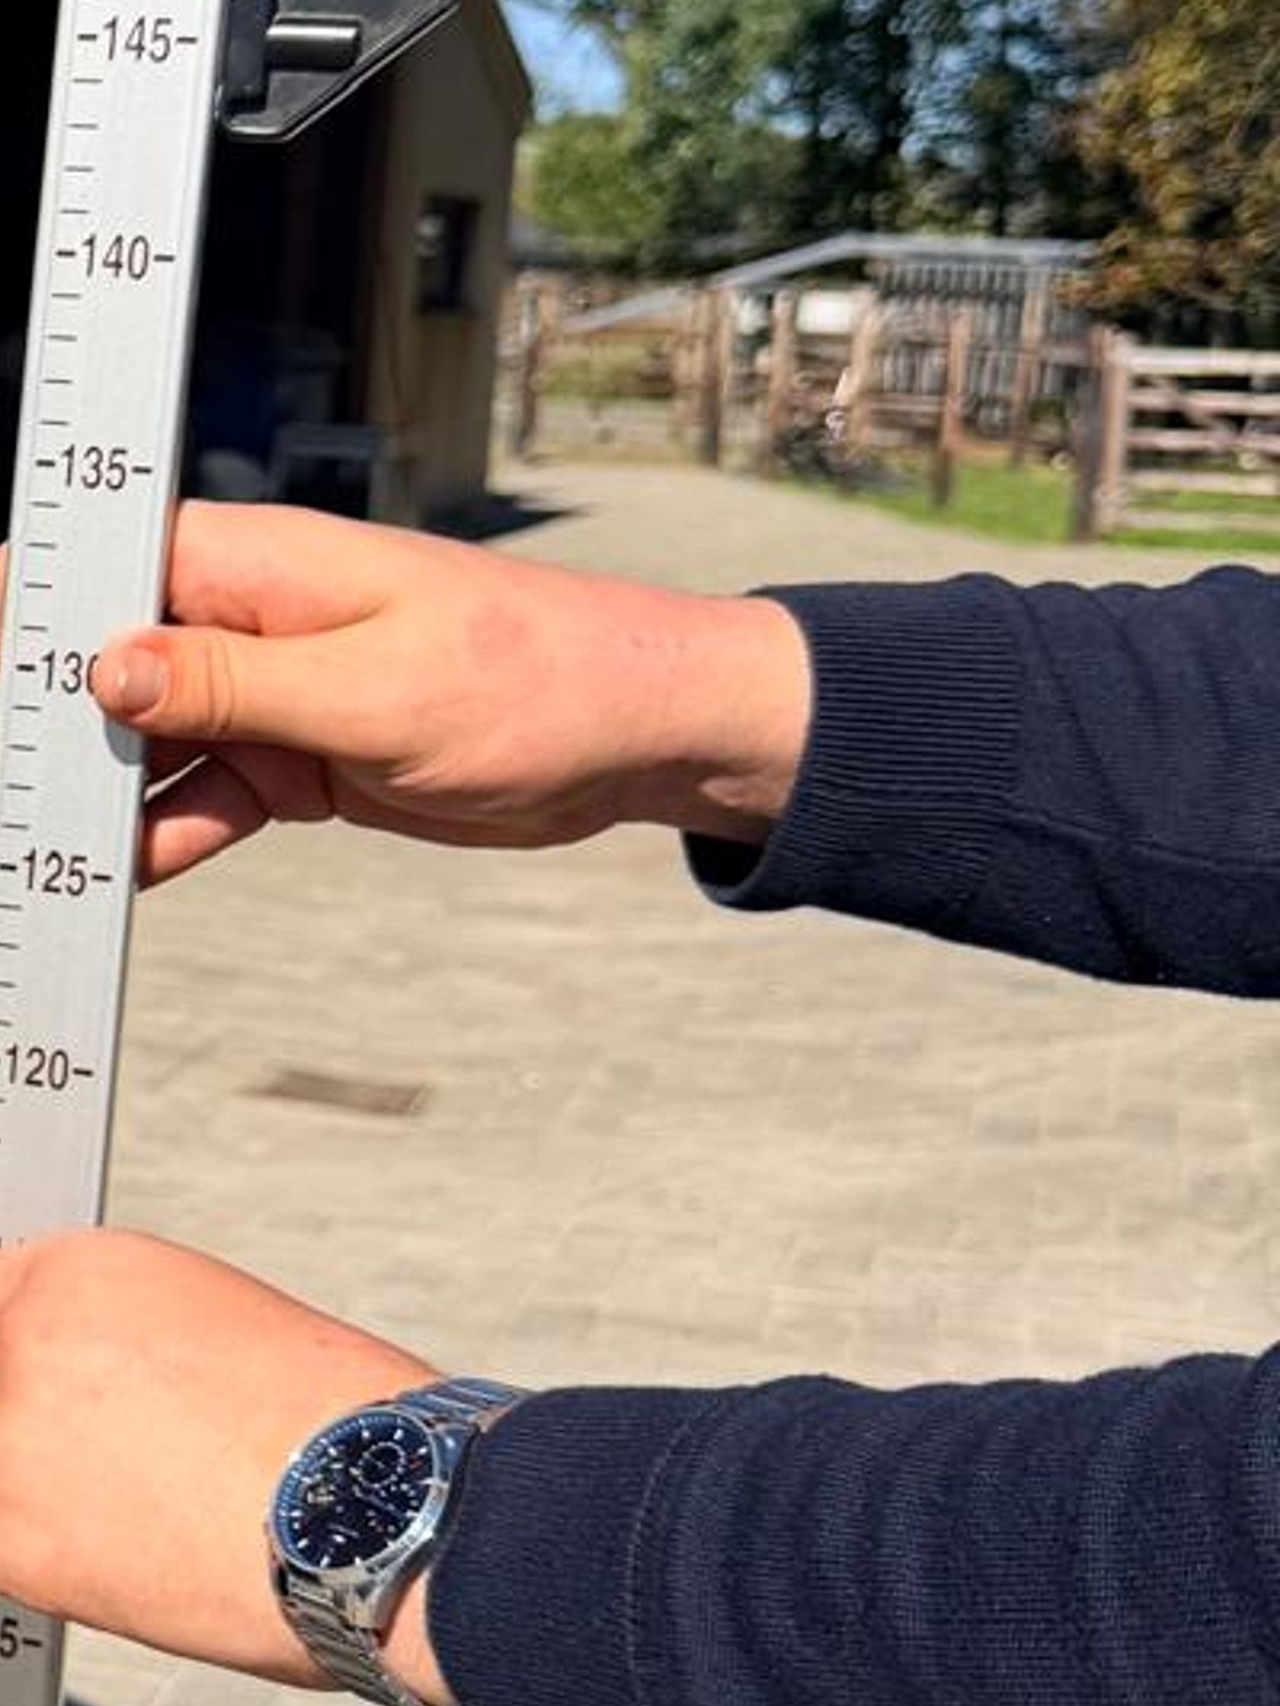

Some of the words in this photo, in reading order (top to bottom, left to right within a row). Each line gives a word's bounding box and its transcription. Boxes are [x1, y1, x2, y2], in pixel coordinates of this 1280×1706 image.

[103, 16, 172, 62] 145
[81, 234, 150, 280] 140
[59, 445, 128, 490] 135
[21, 849, 88, 896] 125
[3, 1044, 70, 1091] 120
